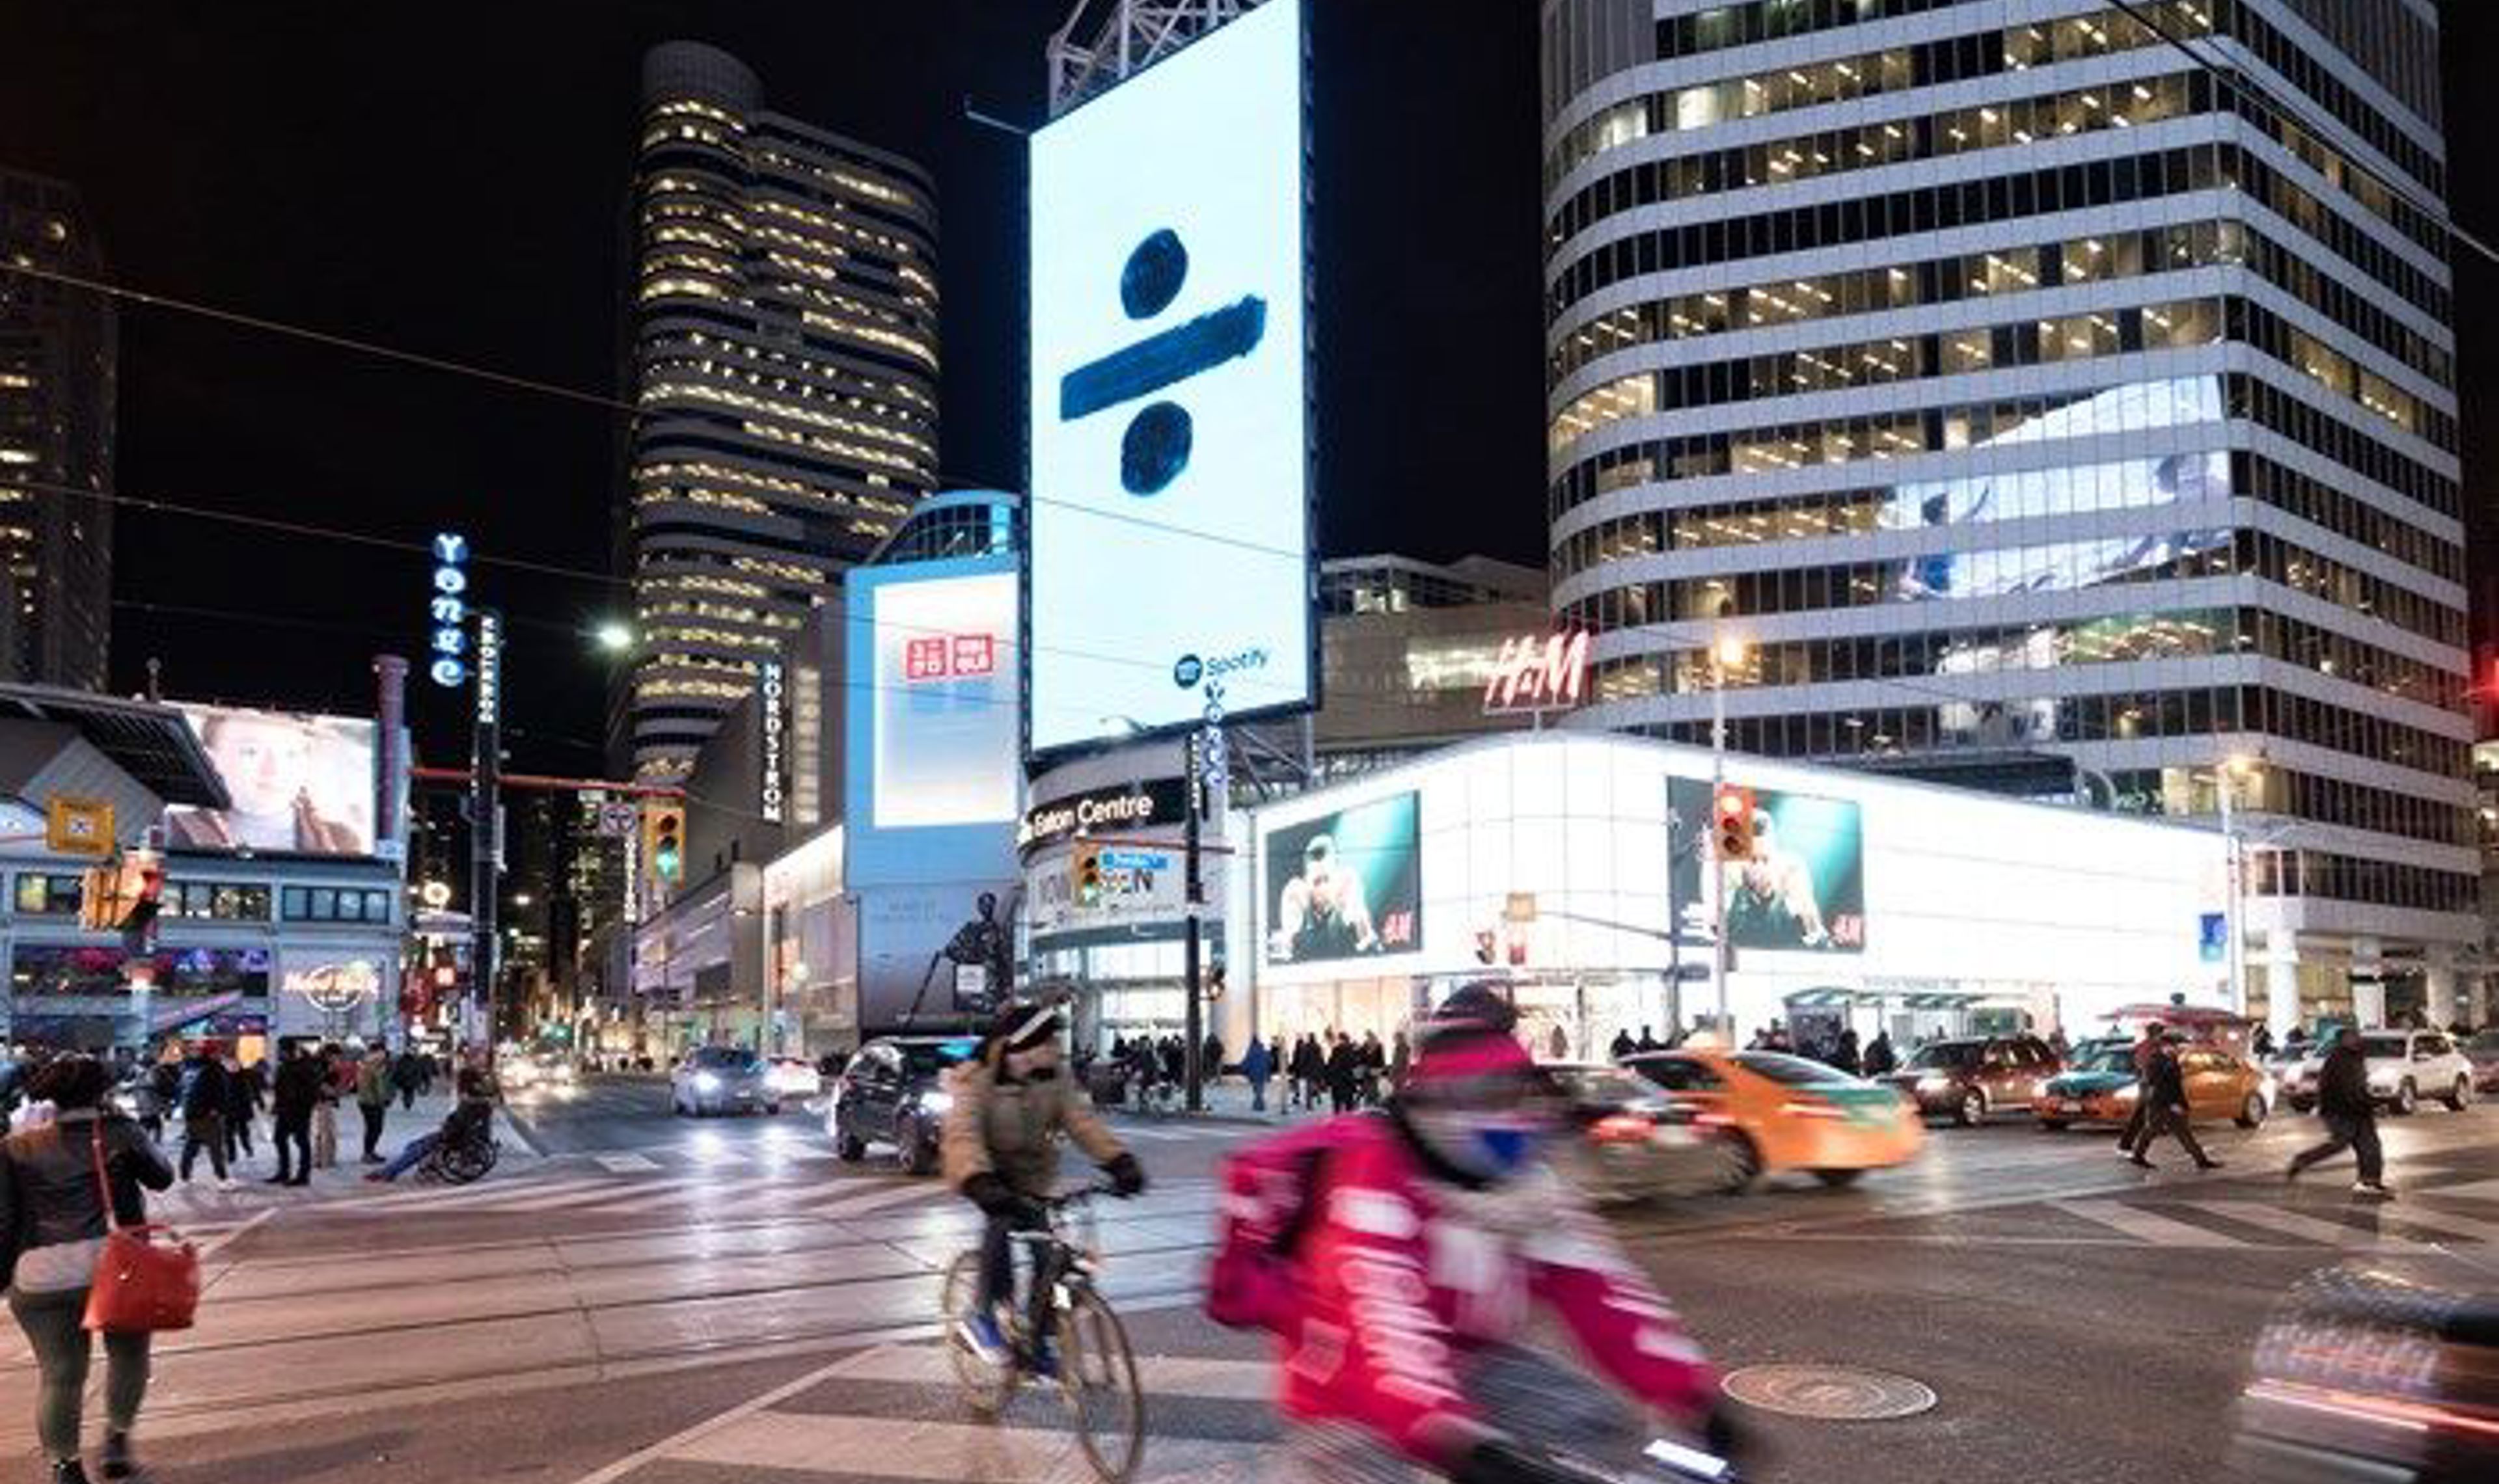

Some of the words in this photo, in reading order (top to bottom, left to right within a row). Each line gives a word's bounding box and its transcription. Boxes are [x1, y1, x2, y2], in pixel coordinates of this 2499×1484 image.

[1206, 649, 1268, 678] Spotify
[1484, 629, 1588, 707] H&M
[763, 662, 782, 821] NORDSTROM
[1034, 810, 1075, 836] Eaton
[1077, 795, 1154, 824] Centre
